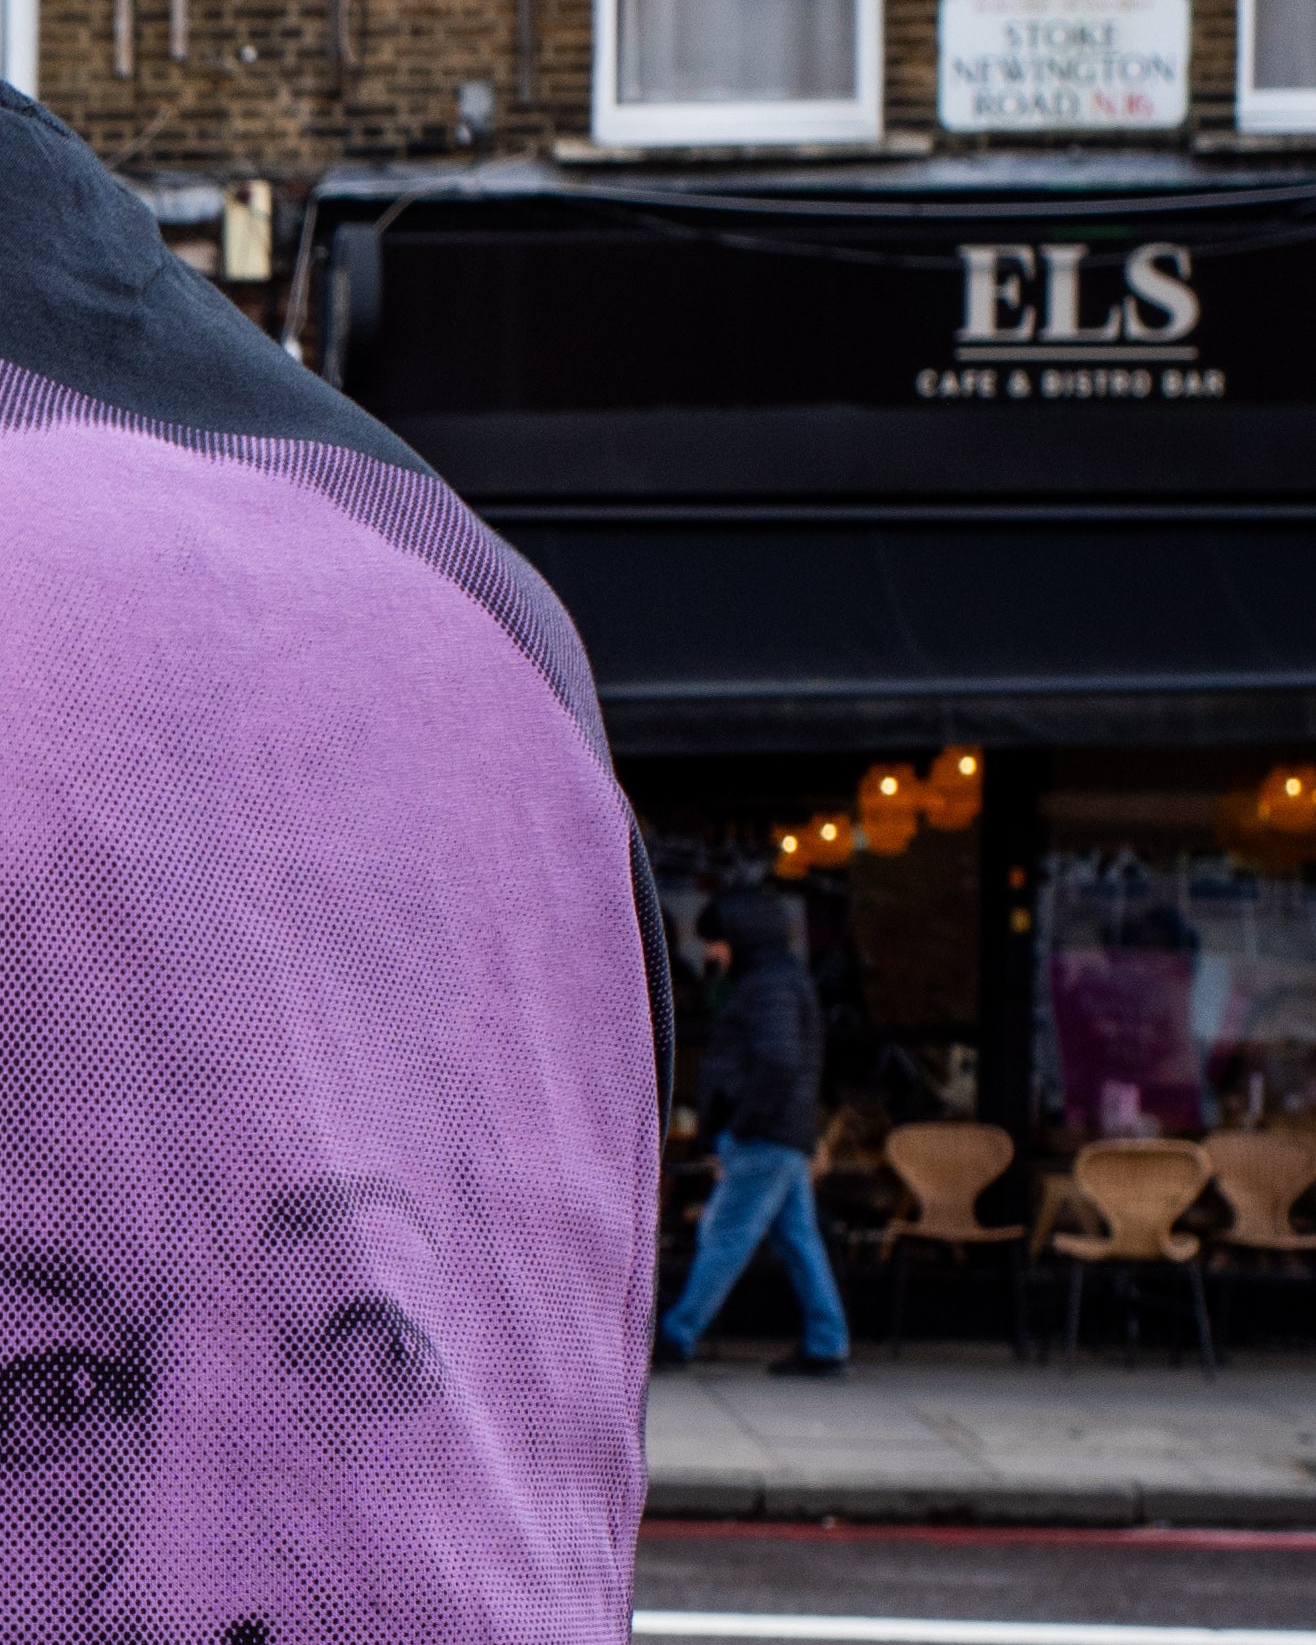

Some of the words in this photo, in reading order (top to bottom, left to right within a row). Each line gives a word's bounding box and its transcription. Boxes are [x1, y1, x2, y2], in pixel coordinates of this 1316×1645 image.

[1005, 17, 1116, 49] STOKE
[952, 52, 1176, 85] NEWINGTON
[973, 90, 1081, 118] ROAD
[954, 241, 1201, 343] ELS
[915, 368, 997, 398] CAFE
[1004, 368, 1032, 398] &
[1039, 368, 1153, 398] BISTRO
[1160, 368, 1226, 398] BAR
